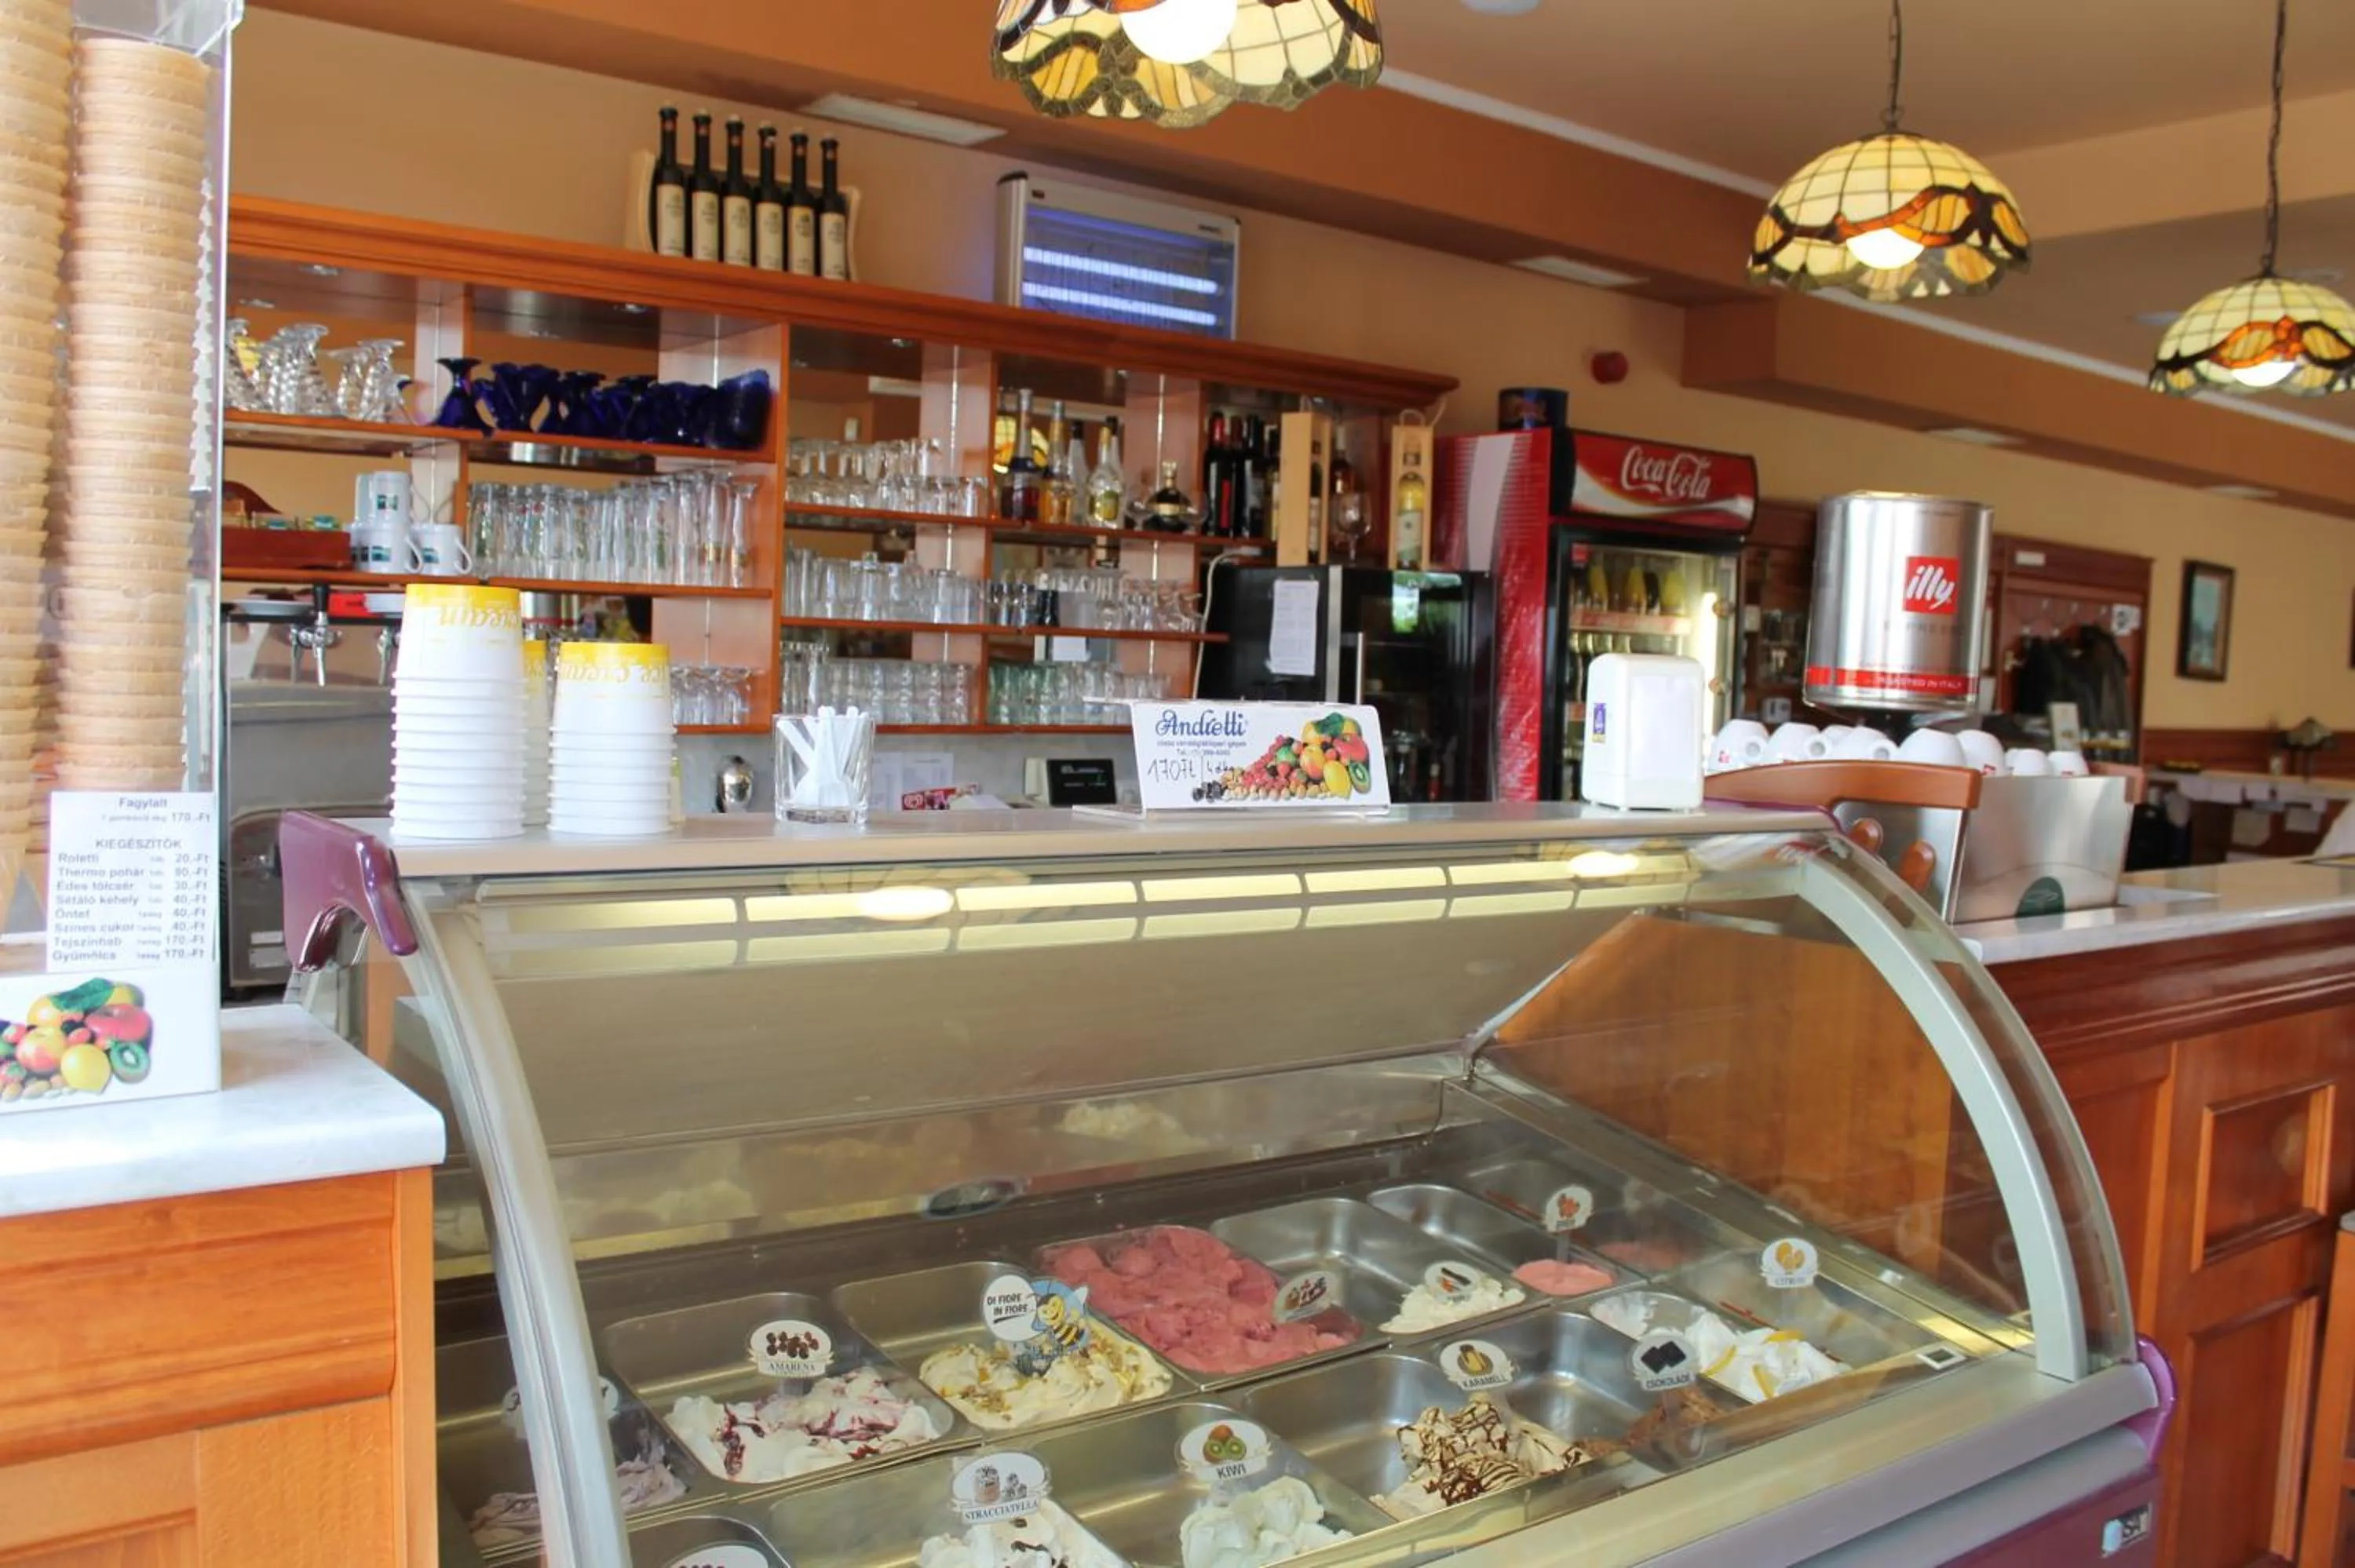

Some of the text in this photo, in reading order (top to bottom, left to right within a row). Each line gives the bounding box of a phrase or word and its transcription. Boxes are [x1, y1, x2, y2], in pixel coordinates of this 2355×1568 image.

[1907, 564, 1955, 610] illy
[1155, 709, 1247, 736] Andretti
[119, 797, 168, 810] Fagylalt
[993, 1307, 1002, 1316] IN
[769, 1362, 816, 1372] AMARENA
[1216, 1463, 1247, 1479] KIWI
[965, 1500, 1038, 1520] STRACCIATELLA
